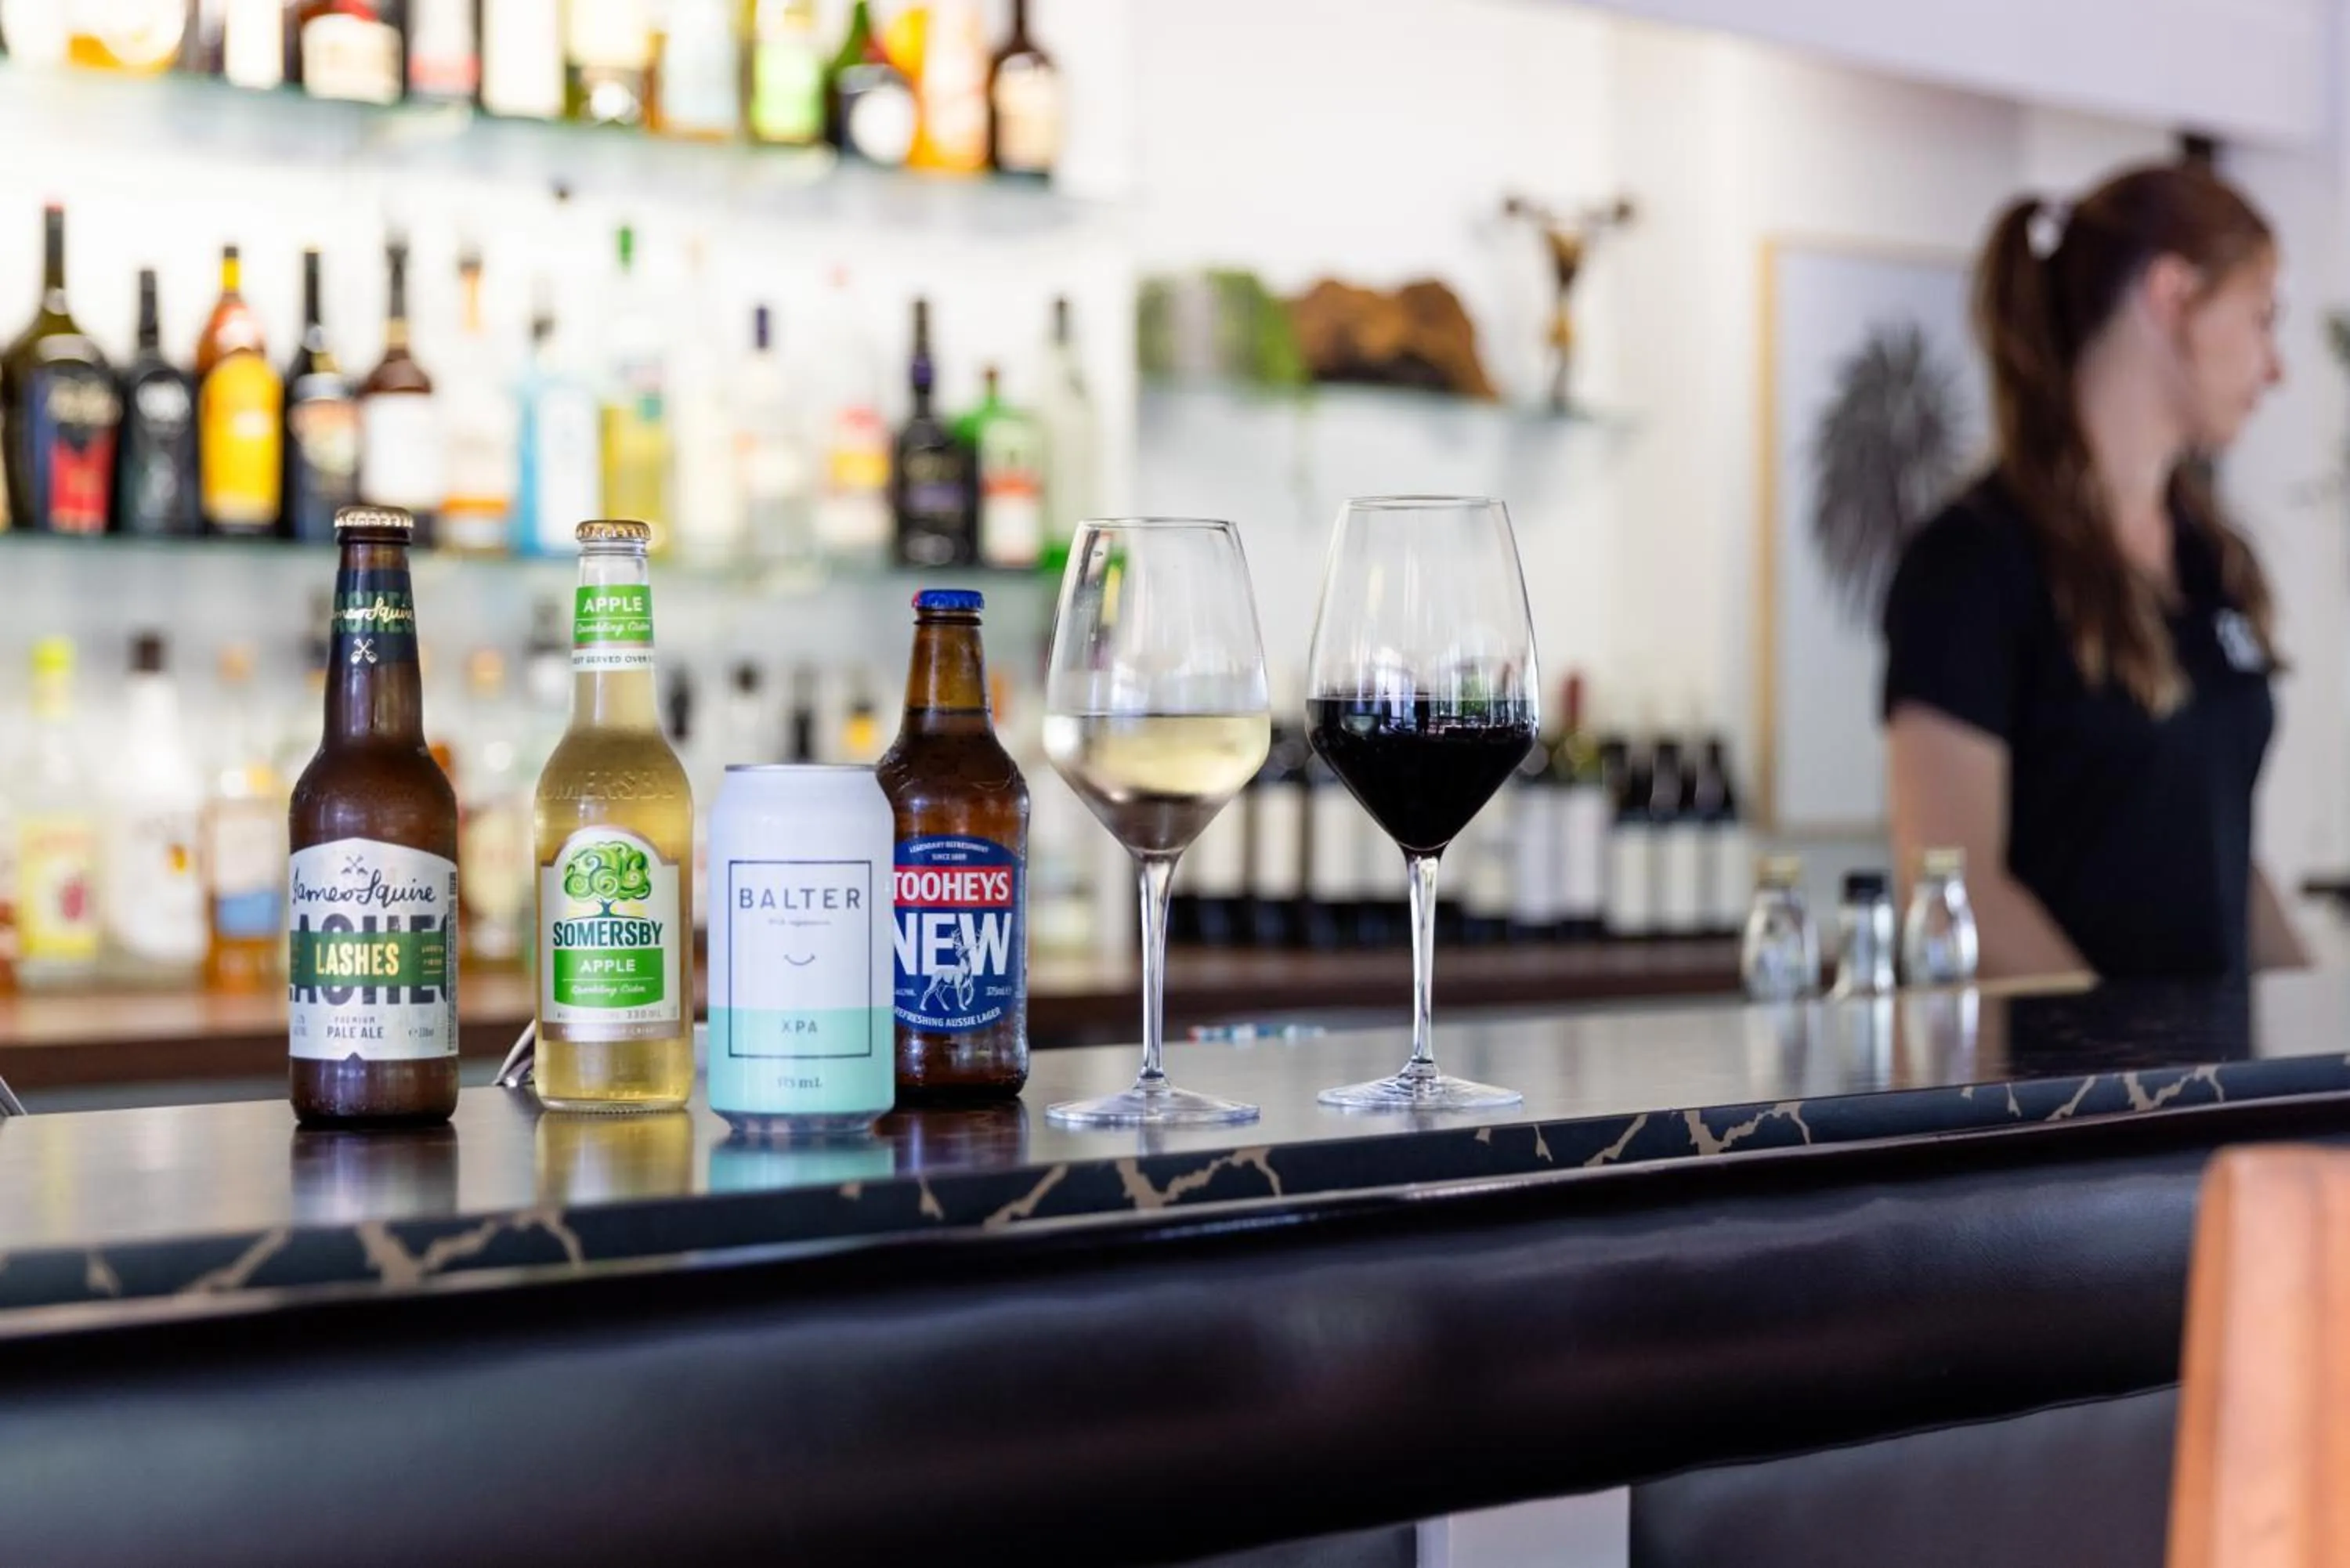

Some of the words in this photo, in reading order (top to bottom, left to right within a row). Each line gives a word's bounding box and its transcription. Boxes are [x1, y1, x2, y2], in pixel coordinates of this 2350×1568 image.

[583, 596, 642, 613] APPLE
[587, 655, 621, 663] SERVED
[355, 869, 436, 909] Squire
[892, 871, 1010, 901] TOOHEYS
[739, 887, 861, 909] BALTER
[553, 920, 663, 947] SOMERSBY
[893, 912, 1012, 976] NEW
[316, 942, 400, 976] LASHES
[580, 958, 636, 974] APPLE
[782, 1021, 819, 1033] XPA
[945, 1015, 976, 1028] AUSSIE
[977, 1006, 1002, 1024] LAGER
[327, 1027, 354, 1039] PALE
[360, 1027, 384, 1039] ALE
